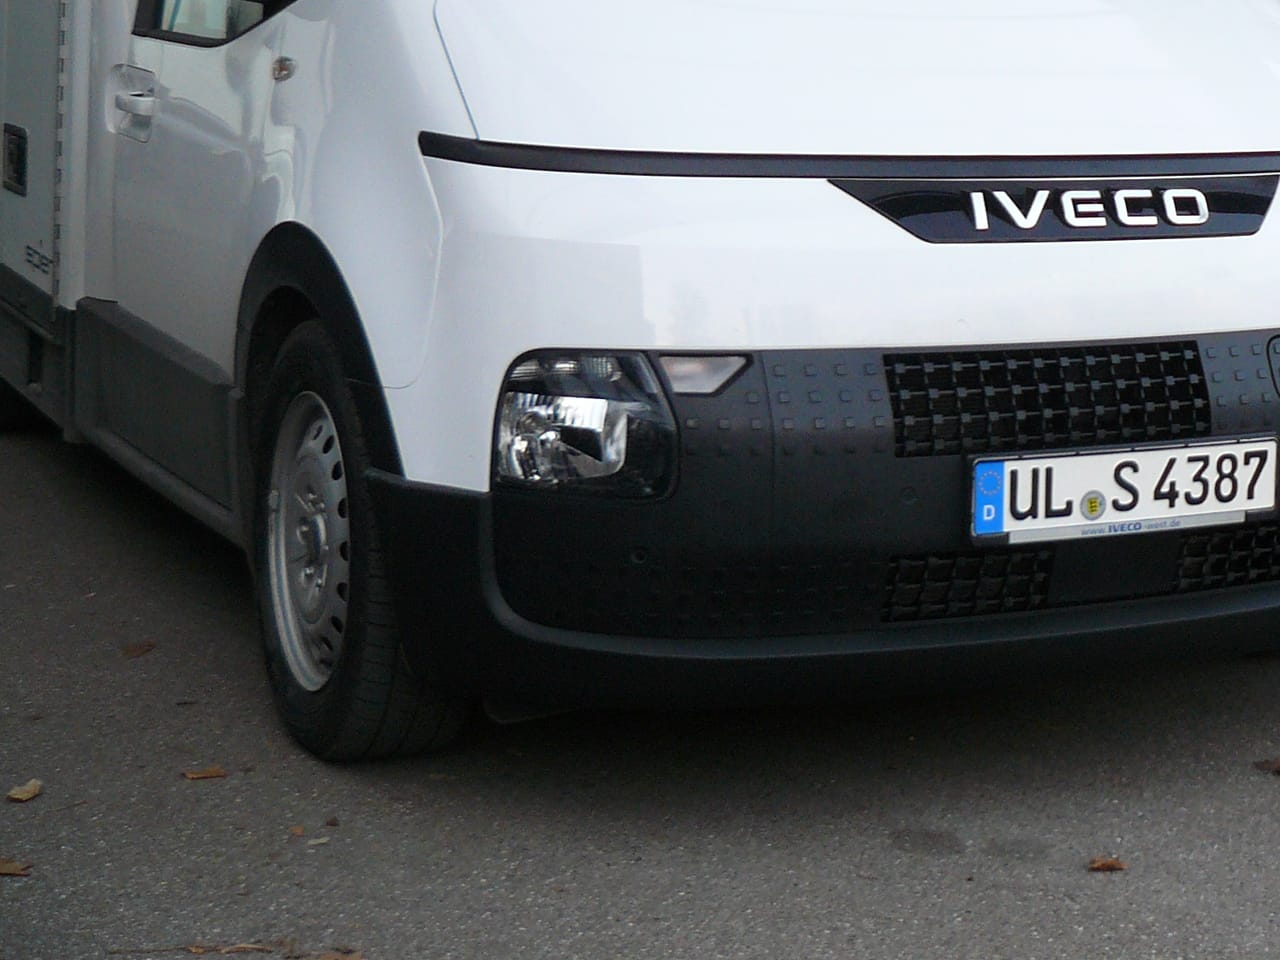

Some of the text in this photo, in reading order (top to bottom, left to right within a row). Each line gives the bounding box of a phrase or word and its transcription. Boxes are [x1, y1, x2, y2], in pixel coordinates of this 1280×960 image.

[970, 188, 1210, 230] IVECO
[983, 504, 996, 520] D
[1009, 466, 1073, 521] UL
